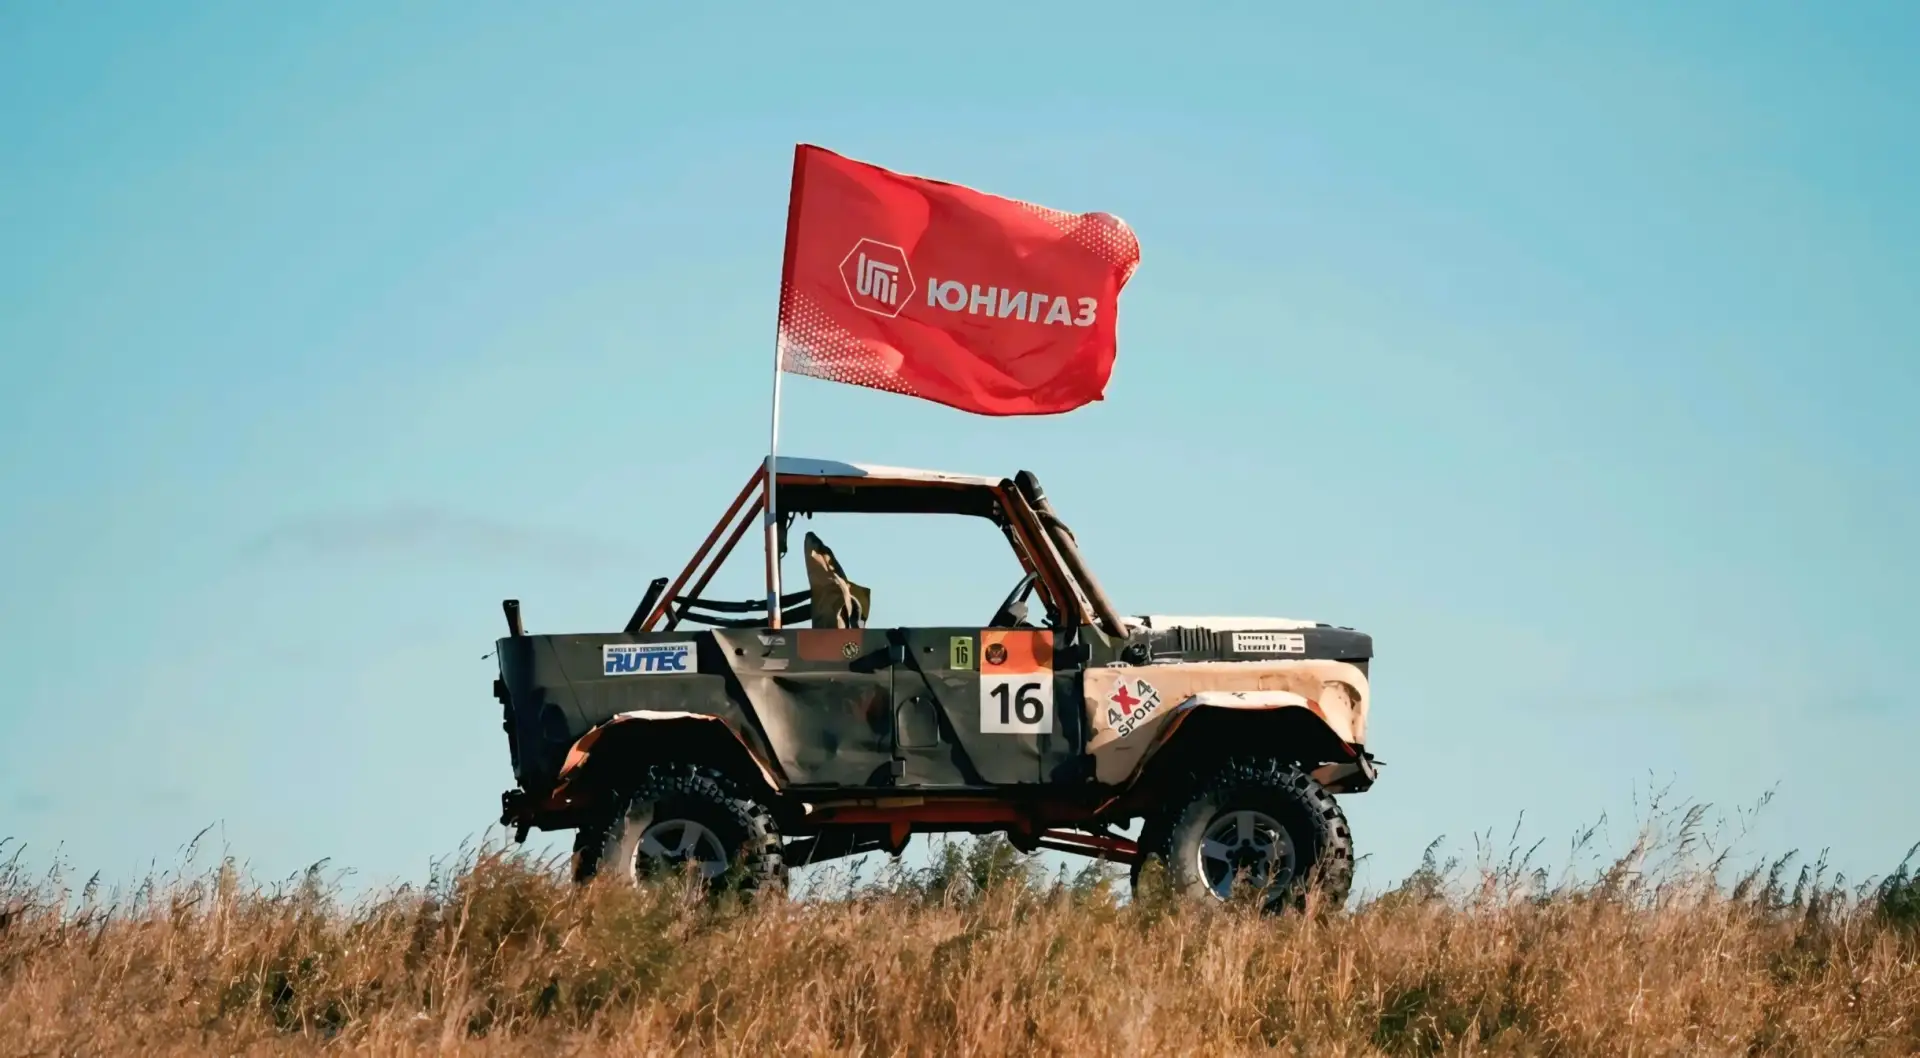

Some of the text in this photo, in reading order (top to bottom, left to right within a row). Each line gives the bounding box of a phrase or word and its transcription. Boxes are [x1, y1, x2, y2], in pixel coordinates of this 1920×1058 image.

[927, 277, 1098, 327] ЮНИГАЗ
[605, 651, 688, 673] RUTEC
[955, 646, 968, 664] 16
[990, 682, 1044, 725] 16
[1118, 691, 1161, 737] SPORT
